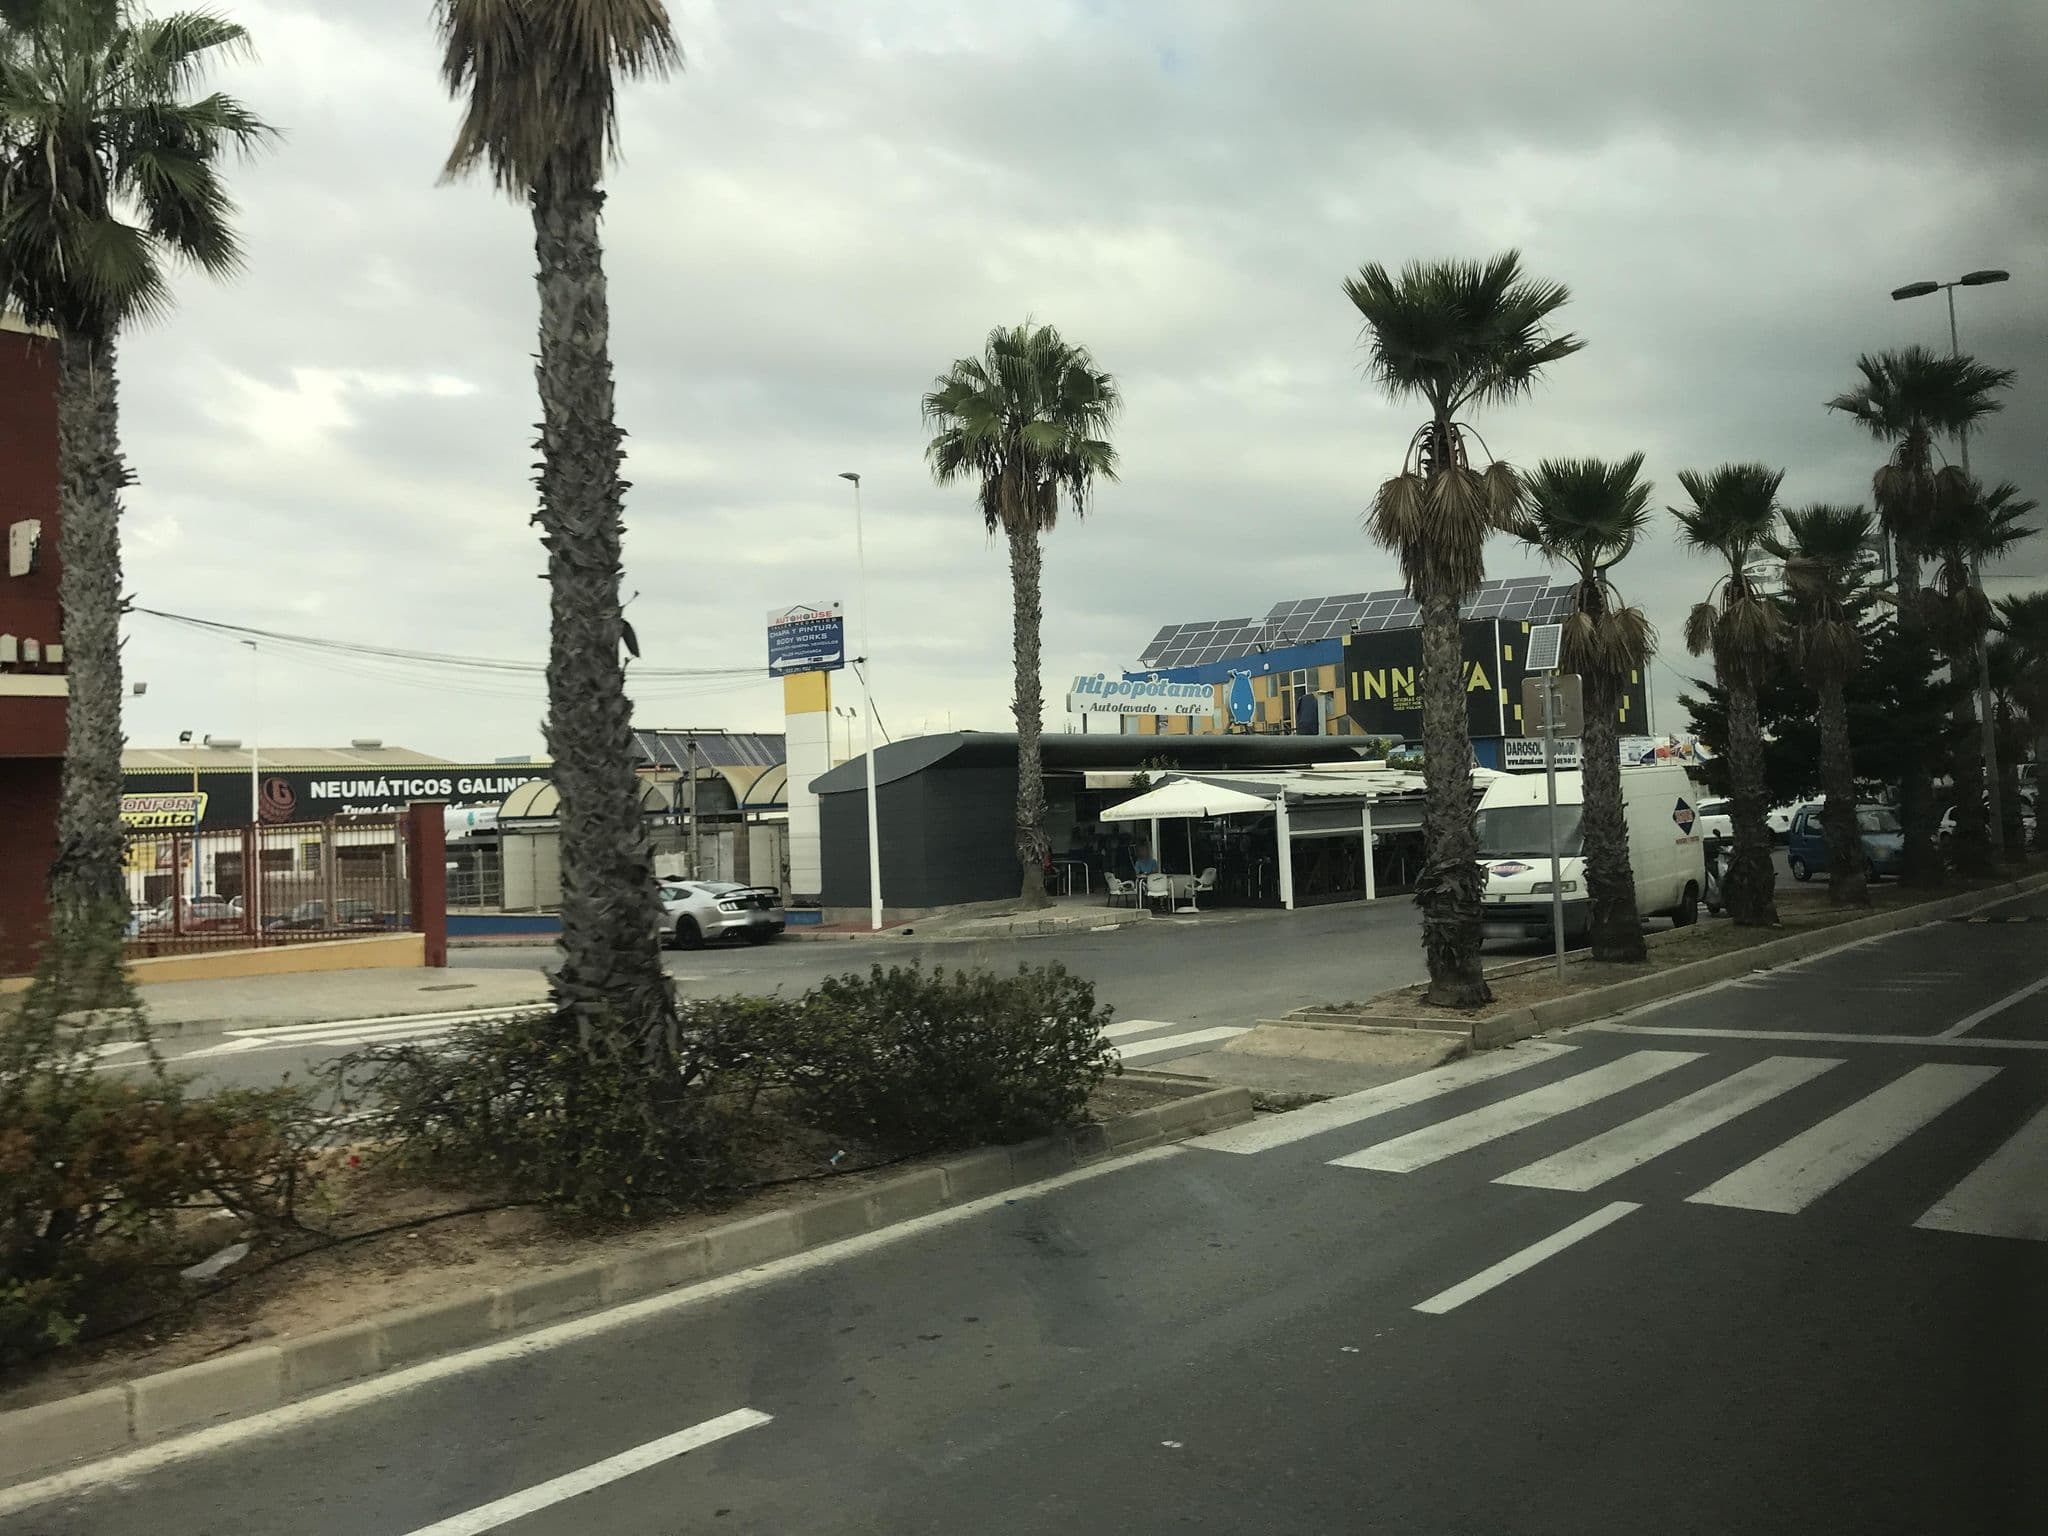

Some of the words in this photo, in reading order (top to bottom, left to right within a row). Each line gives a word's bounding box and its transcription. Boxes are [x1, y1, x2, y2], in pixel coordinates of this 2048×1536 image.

[776, 611, 832, 624] AUTOHOUSE
[799, 624, 838, 633] PINTURA
[777, 637, 794, 645] BODY
[796, 633, 827, 642] WORKS
[1076, 674, 1213, 699] Hipopótamo
[1352, 661, 1491, 700] INNA
[1090, 702, 1157, 713] Autolavado
[1175, 704, 1201, 714] Café
[1507, 742, 1543, 756] DAROSOL
[310, 776, 452, 799] NEUMÁTICOS
[458, 777, 541, 794] GALIN
[121, 798, 200, 812] ONFORT
